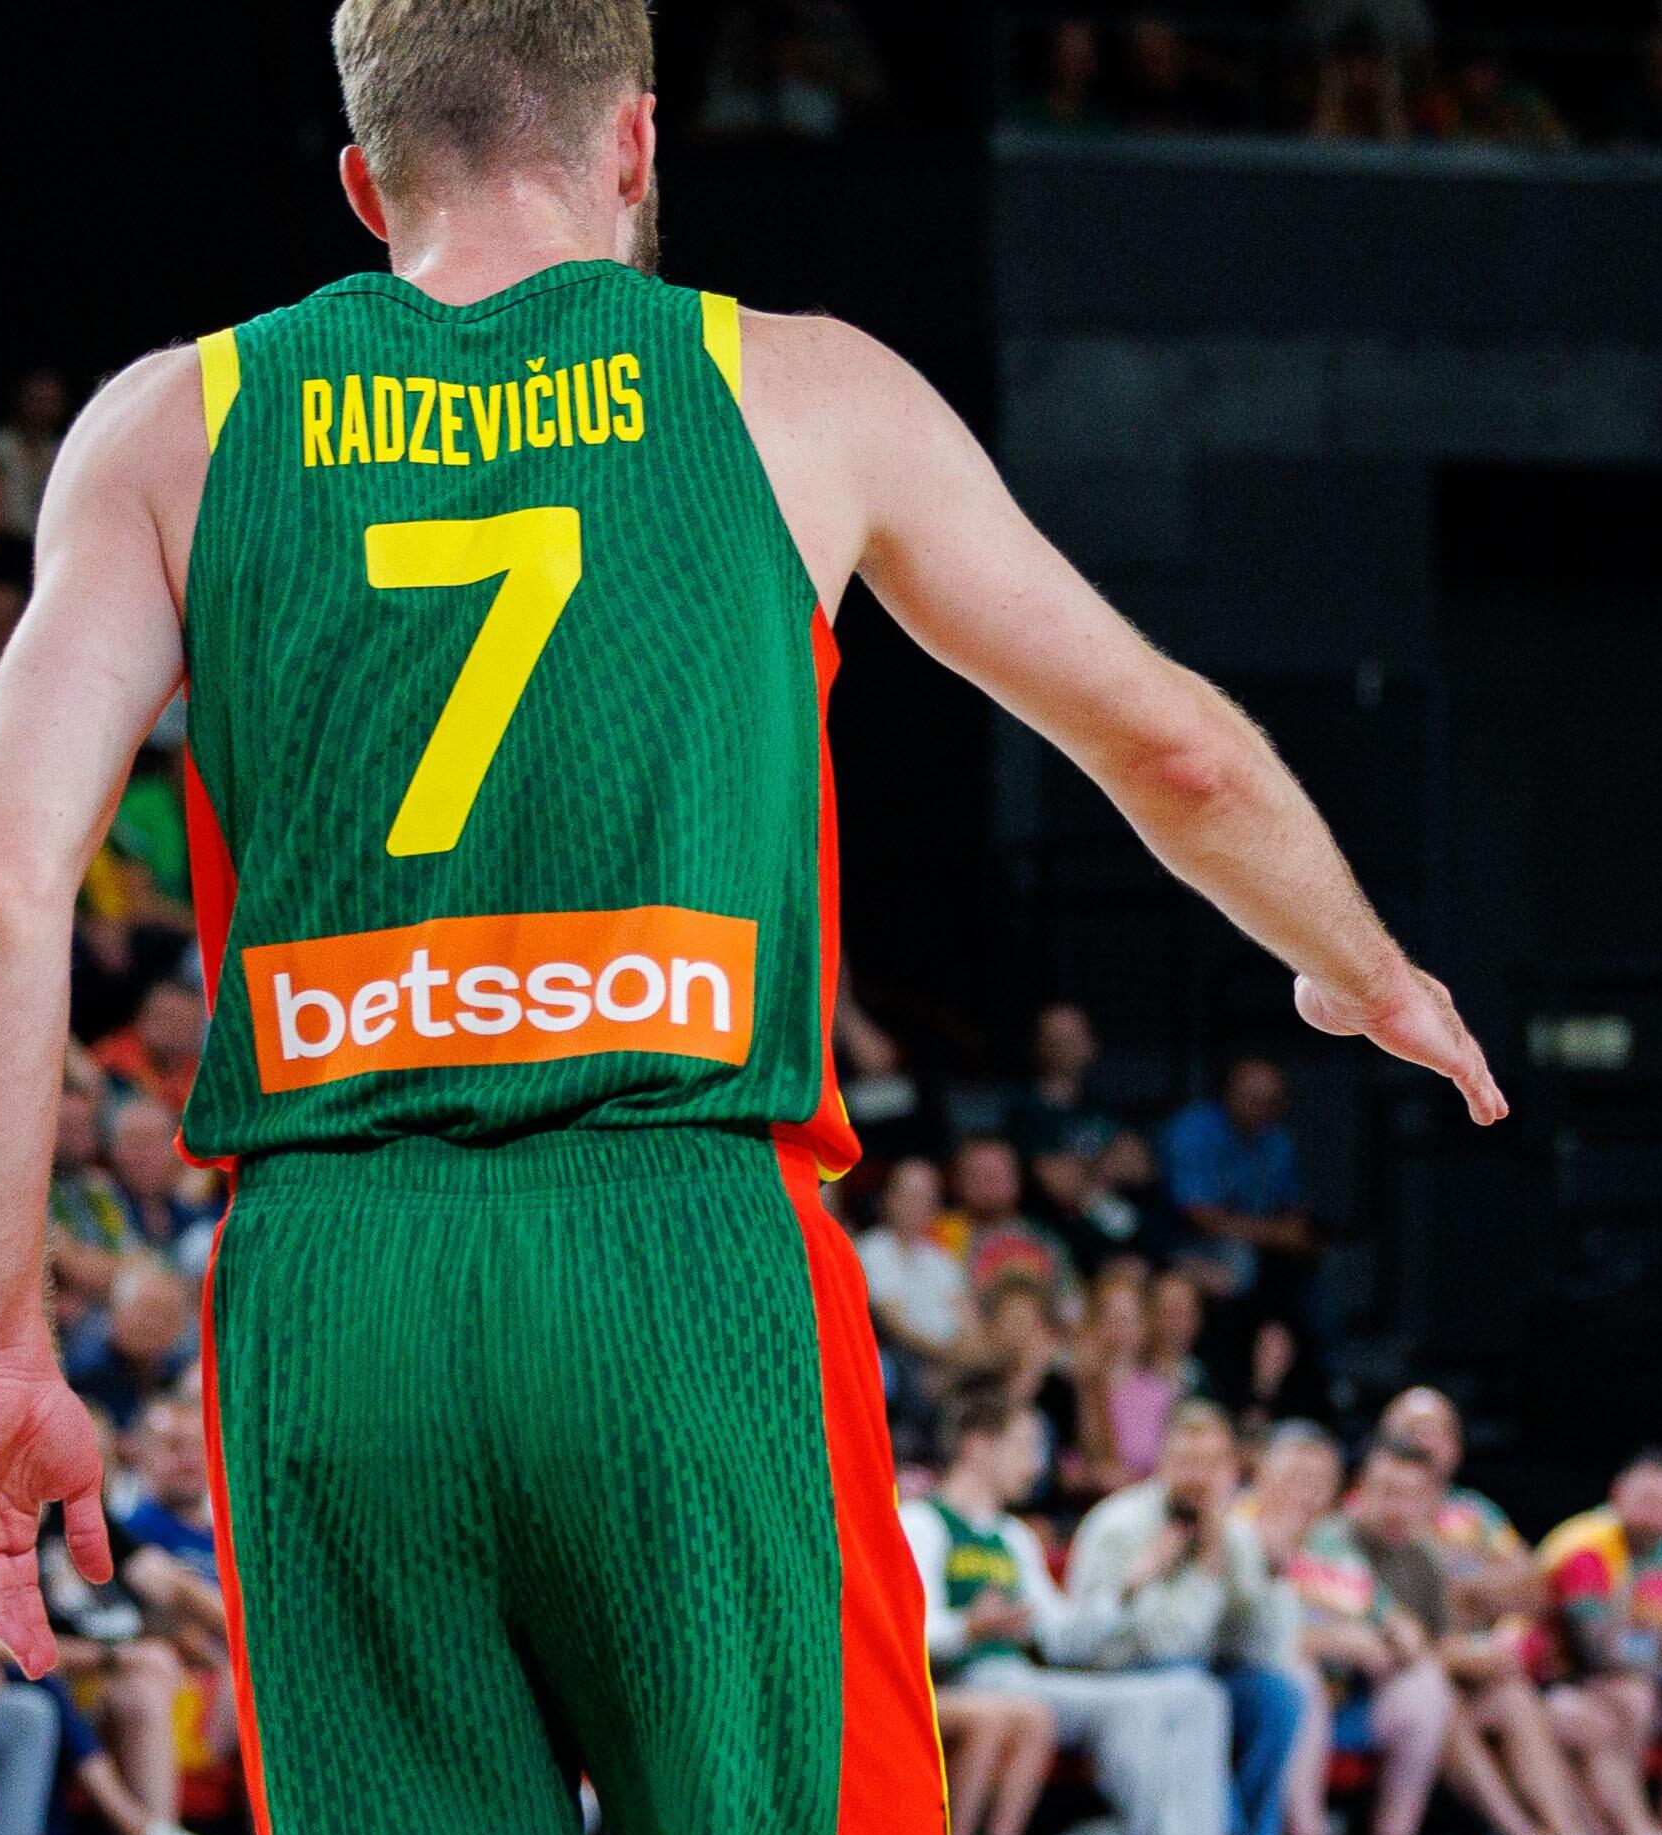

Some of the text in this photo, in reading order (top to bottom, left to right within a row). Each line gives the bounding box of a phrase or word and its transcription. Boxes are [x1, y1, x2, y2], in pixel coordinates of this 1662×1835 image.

[302, 351, 647, 469] RADZEVIČIUS
[364, 505, 583, 858] 7
[273, 948, 731, 1061] betsson
